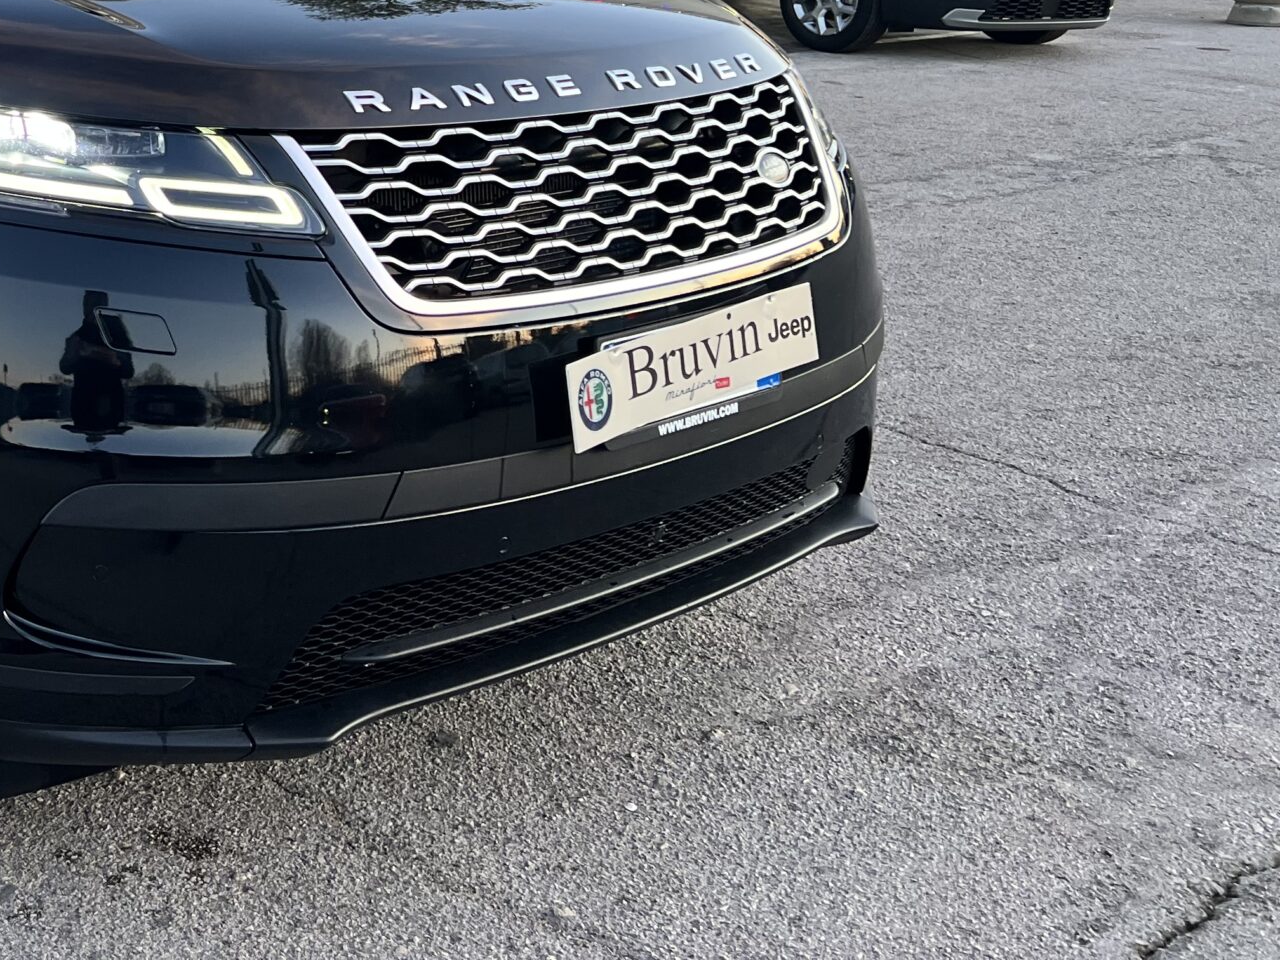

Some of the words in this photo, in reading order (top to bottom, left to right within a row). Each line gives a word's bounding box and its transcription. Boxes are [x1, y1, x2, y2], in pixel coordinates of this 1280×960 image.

[342, 73, 582, 114] RANGE
[605, 52, 761, 90] ROVER
[767, 315, 813, 343] Jeep
[623, 312, 763, 401] Bruvin
[657, 402, 739, 436] WWW.BRUVIN.COM
